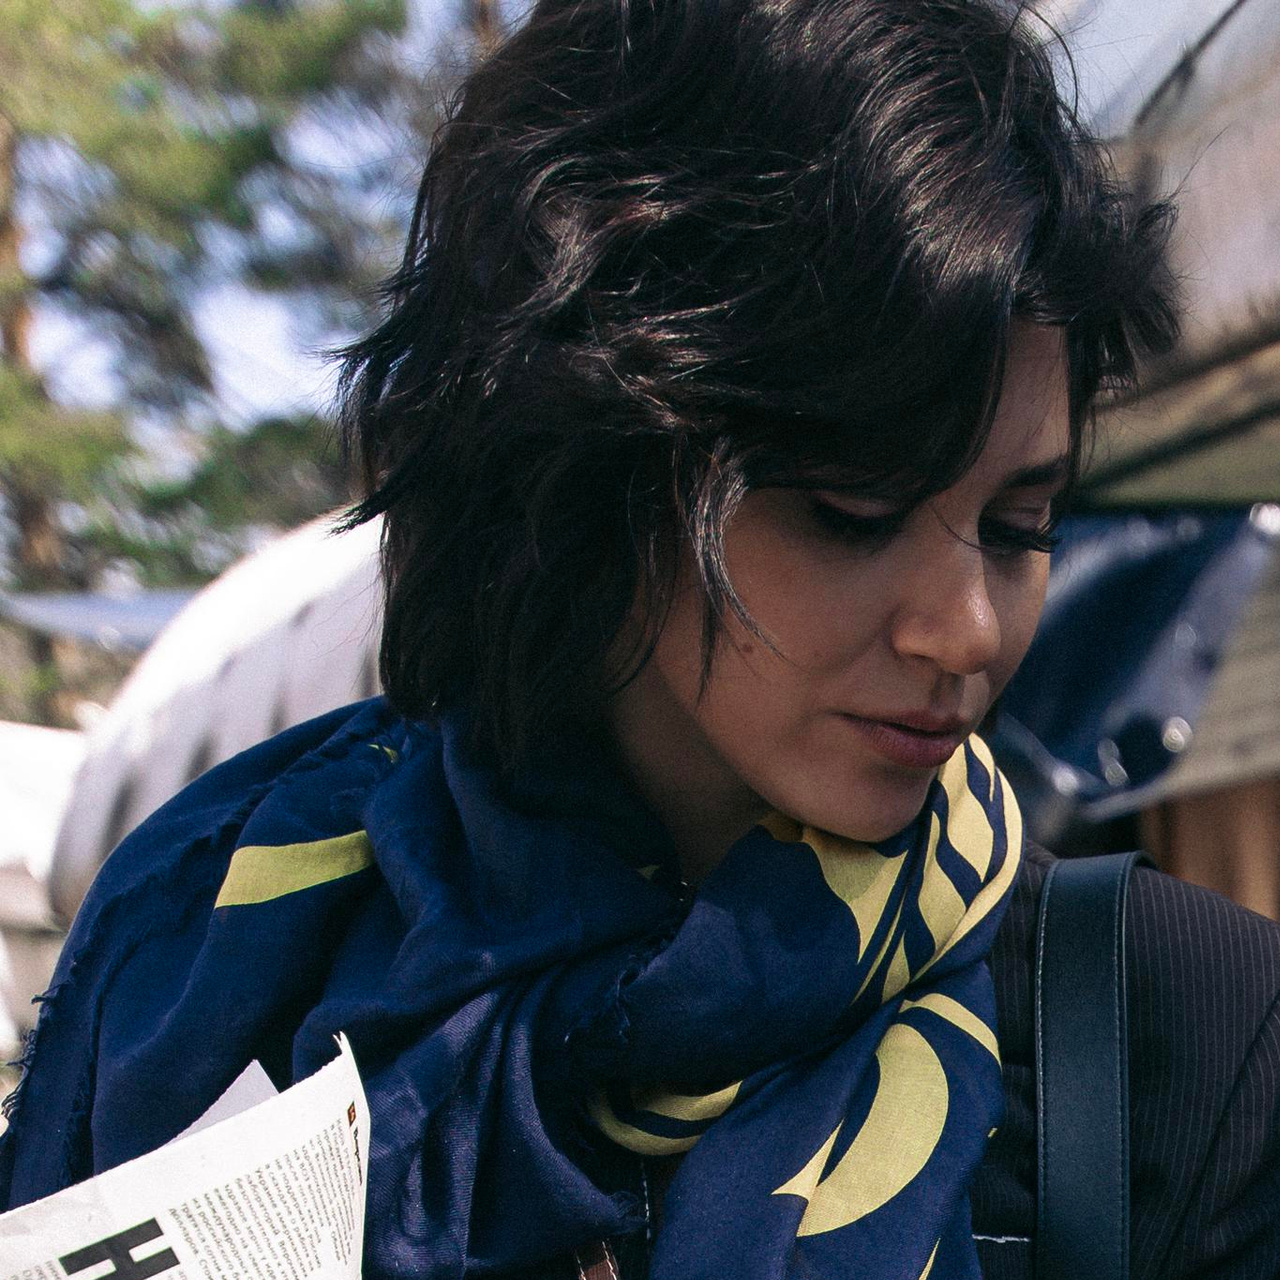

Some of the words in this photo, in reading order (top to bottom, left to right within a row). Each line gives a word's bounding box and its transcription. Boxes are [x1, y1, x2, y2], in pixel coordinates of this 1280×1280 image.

[181, 1201, 206, 1243] тратятся
[204, 1244, 222, 1273] сотни
[198, 1211, 234, 1271] российского
